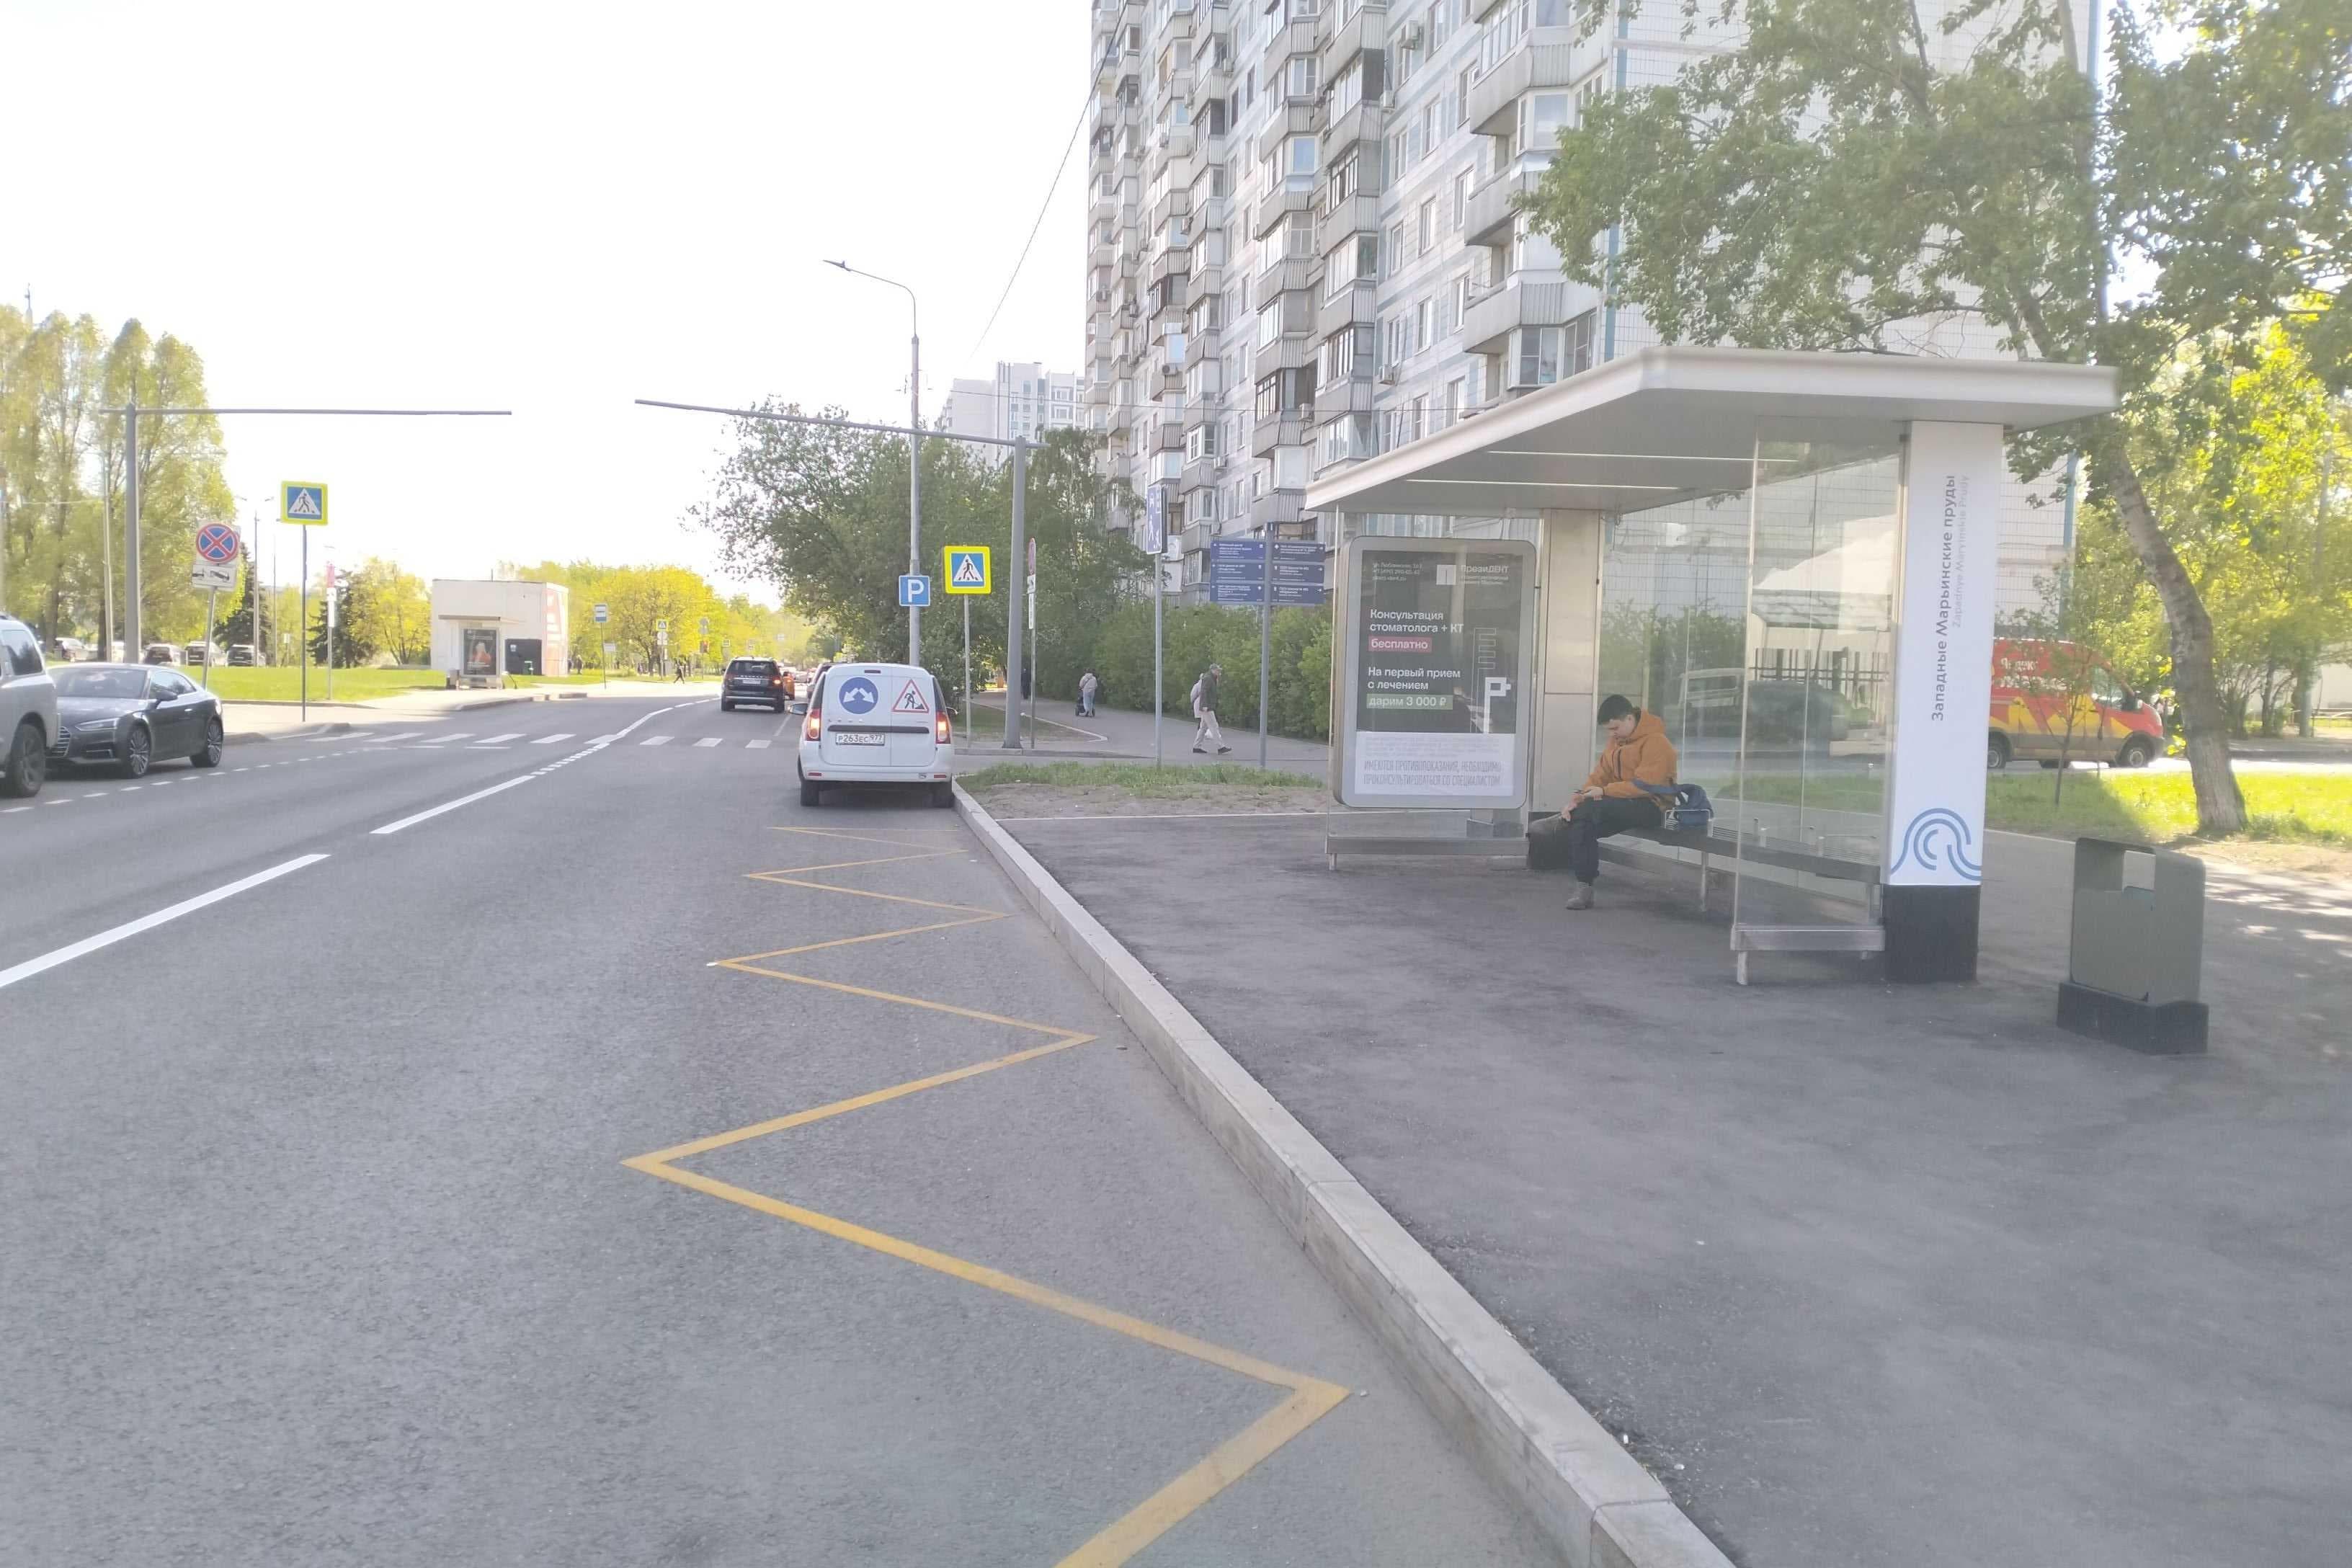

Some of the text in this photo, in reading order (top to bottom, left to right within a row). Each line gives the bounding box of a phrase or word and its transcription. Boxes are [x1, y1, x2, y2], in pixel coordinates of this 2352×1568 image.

[908, 579, 925, 602] P
[1932, 476, 1956, 721] Западные Марьинские пруды
[1370, 609, 1444, 620] Консультация
[1369, 623, 1438, 633] стоматолога
[1450, 623, 1464, 633] КТ
[1371, 638, 1428, 649] бесплатно
[1368, 667, 1461, 680] На первый прием
[1377, 681, 1429, 690] лечением
[1369, 697, 1404, 707] дарим
[1364, 760, 1394, 771] ИМЕЮТСЯ
